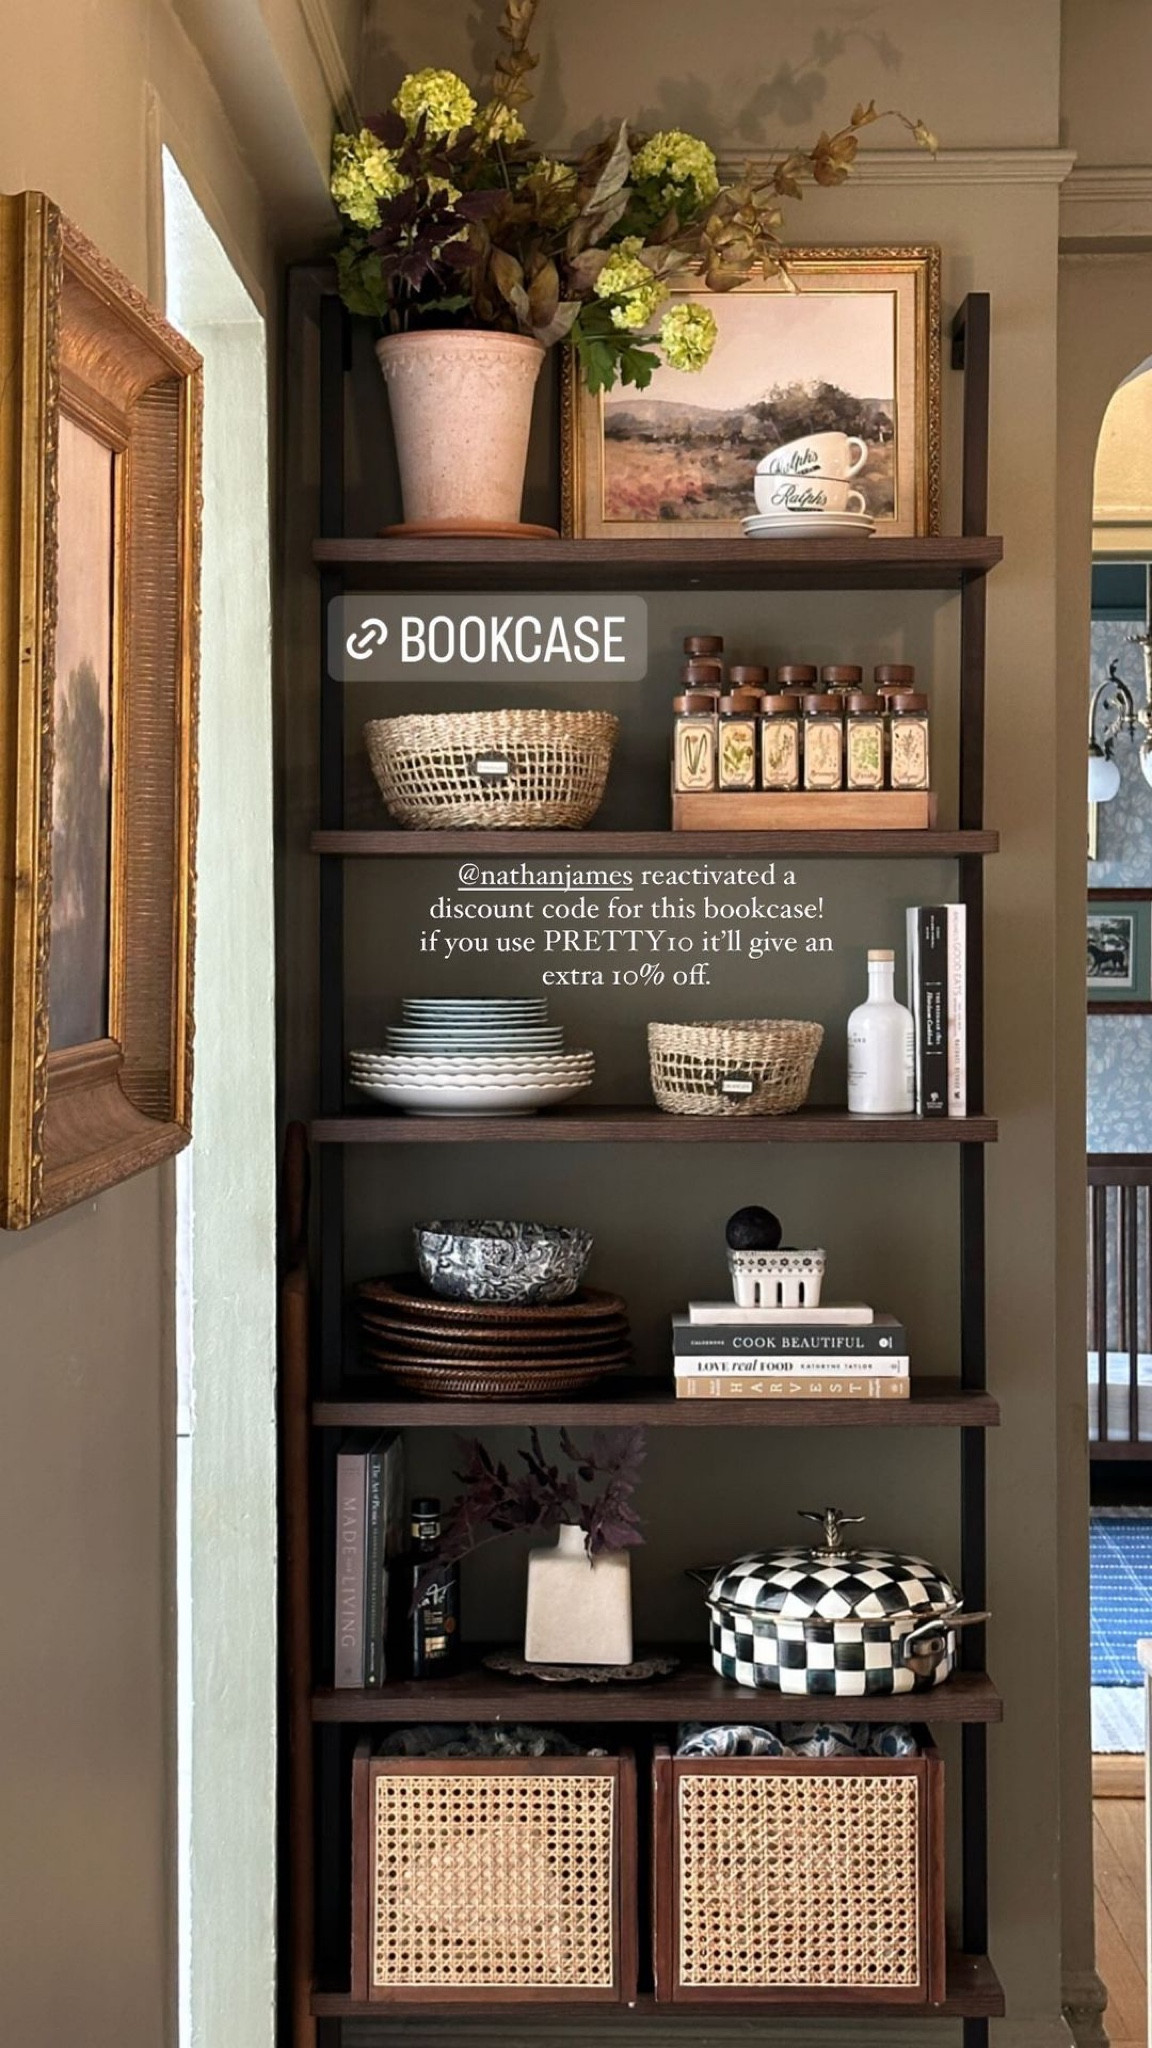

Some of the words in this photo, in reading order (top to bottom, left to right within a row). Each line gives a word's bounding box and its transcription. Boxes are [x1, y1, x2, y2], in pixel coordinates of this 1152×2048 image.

[953, 942, 963, 972] GOOD
[953, 973, 963, 996] EATS
[732, 1336, 777, 1349] COOK
[782, 1336, 865, 1349] BEAUTIFUL
[698, 1361, 729, 1372] LOVE
[731, 1359, 758, 1372] real
[760, 1361, 794, 1372] FOOD
[731, 1382, 864, 1393] HARVEST
[371, 1464, 381, 1479] The
[371, 1482, 380, 1493] Art
[342, 1497, 357, 1555] MADE
[341, 1576, 356, 1648] LIVING
